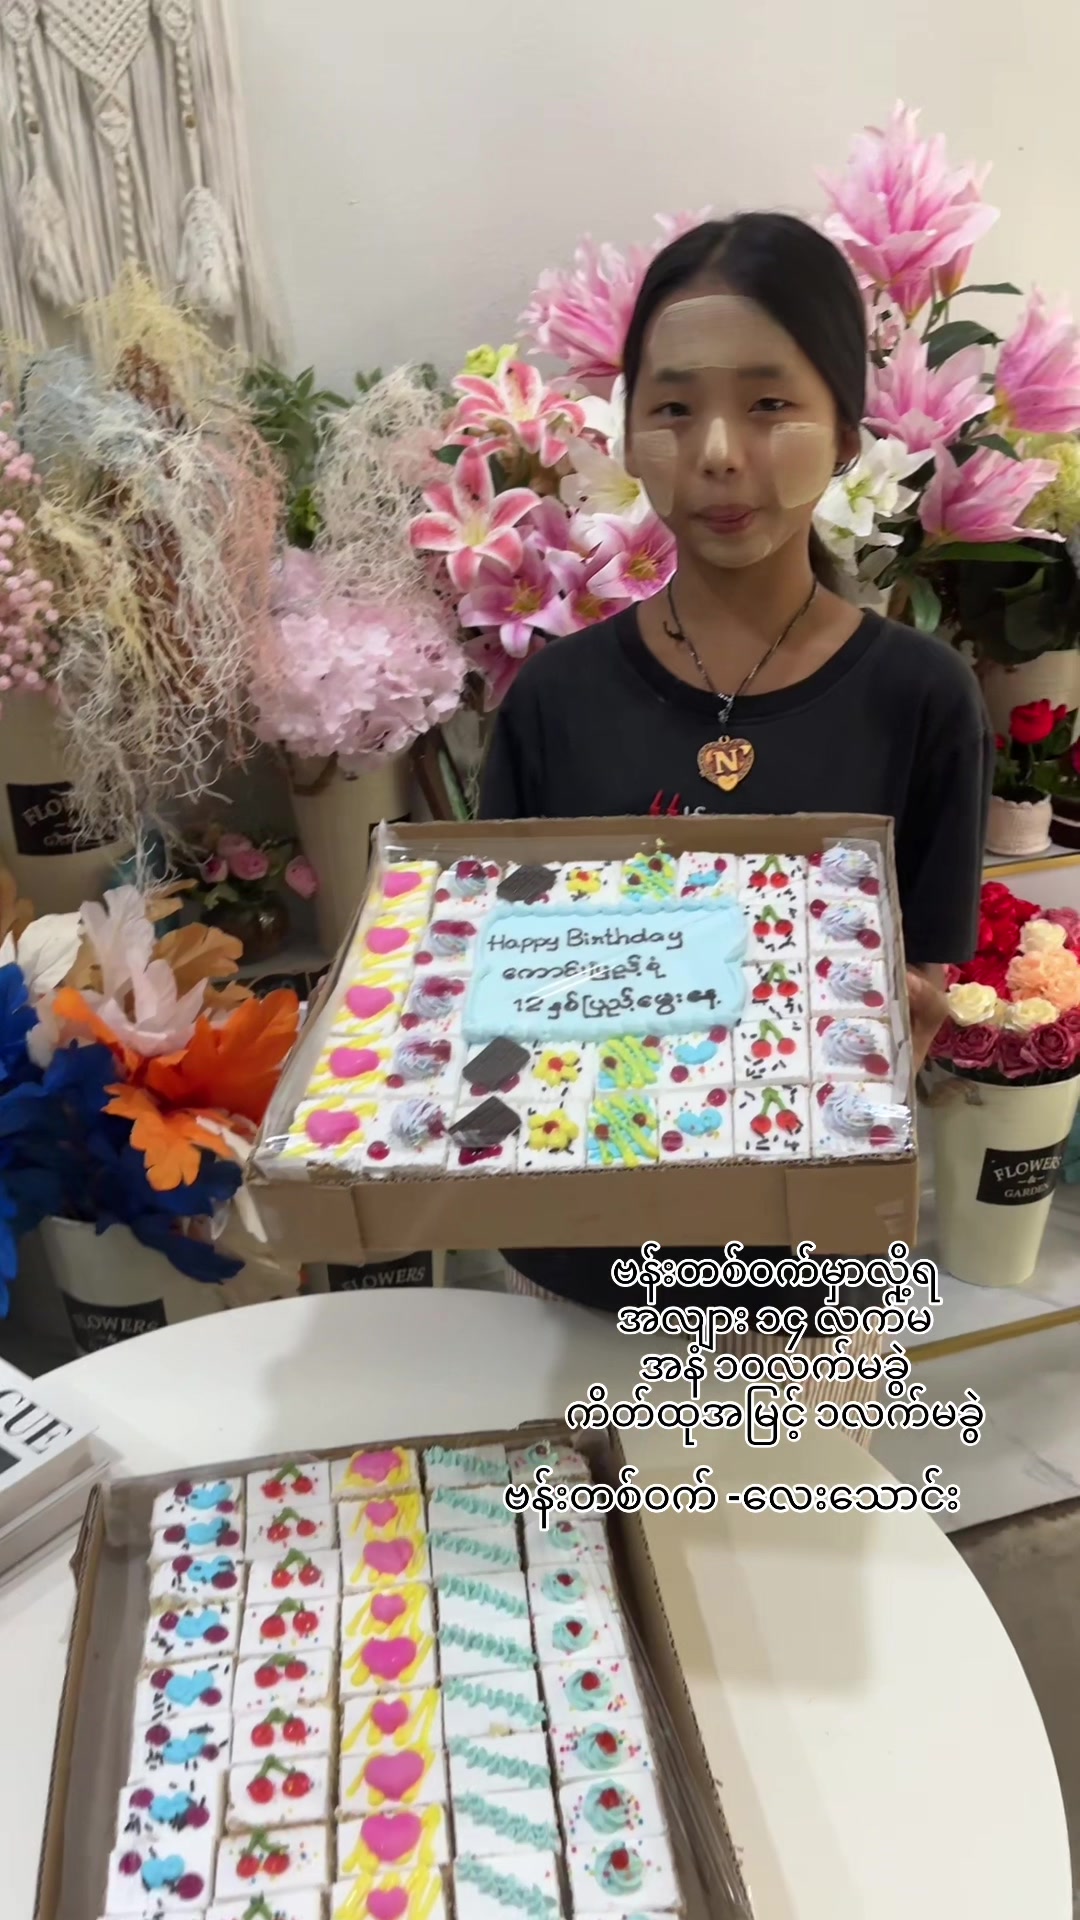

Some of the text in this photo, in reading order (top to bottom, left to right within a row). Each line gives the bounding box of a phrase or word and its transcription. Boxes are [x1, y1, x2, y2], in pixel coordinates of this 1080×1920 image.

[713, 750, 739, 774] N
[487, 927, 683, 953] Happy Birthday
[993, 1156, 1062, 1182] FLOWERS
